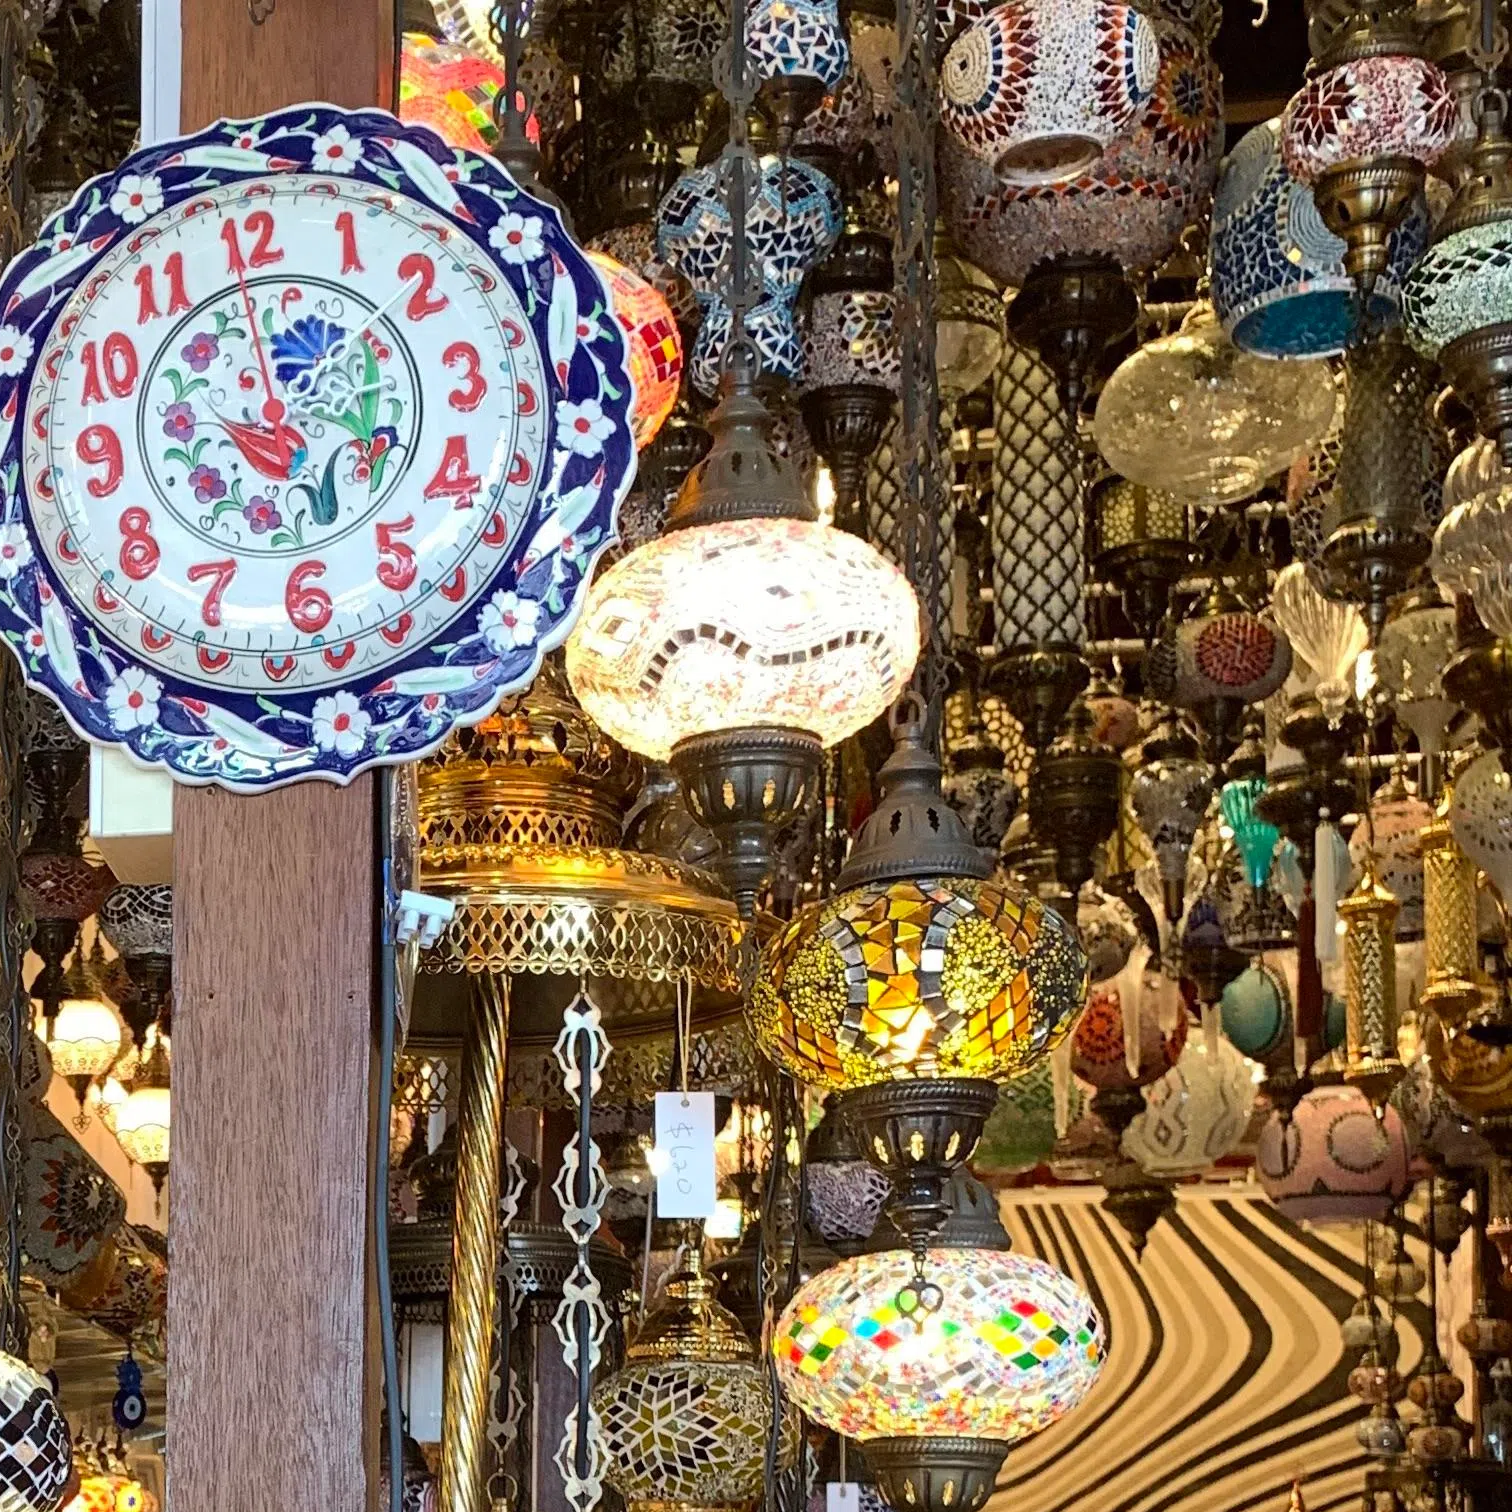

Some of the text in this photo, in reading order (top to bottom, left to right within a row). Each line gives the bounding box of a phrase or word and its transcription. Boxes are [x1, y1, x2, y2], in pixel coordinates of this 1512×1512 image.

[220, 210, 284, 275] 12
[333, 211, 365, 274] 1
[135, 251, 193, 325] 11
[396, 252, 451, 321] 2
[79, 331, 138, 405] 10
[441, 341, 487, 412] 3
[76, 424, 125, 497] 9
[423, 434, 482, 509] 4
[118, 507, 161, 580] 8
[375, 512, 418, 591] 5
[187, 558, 237, 626] 7
[284, 559, 334, 632] 6
